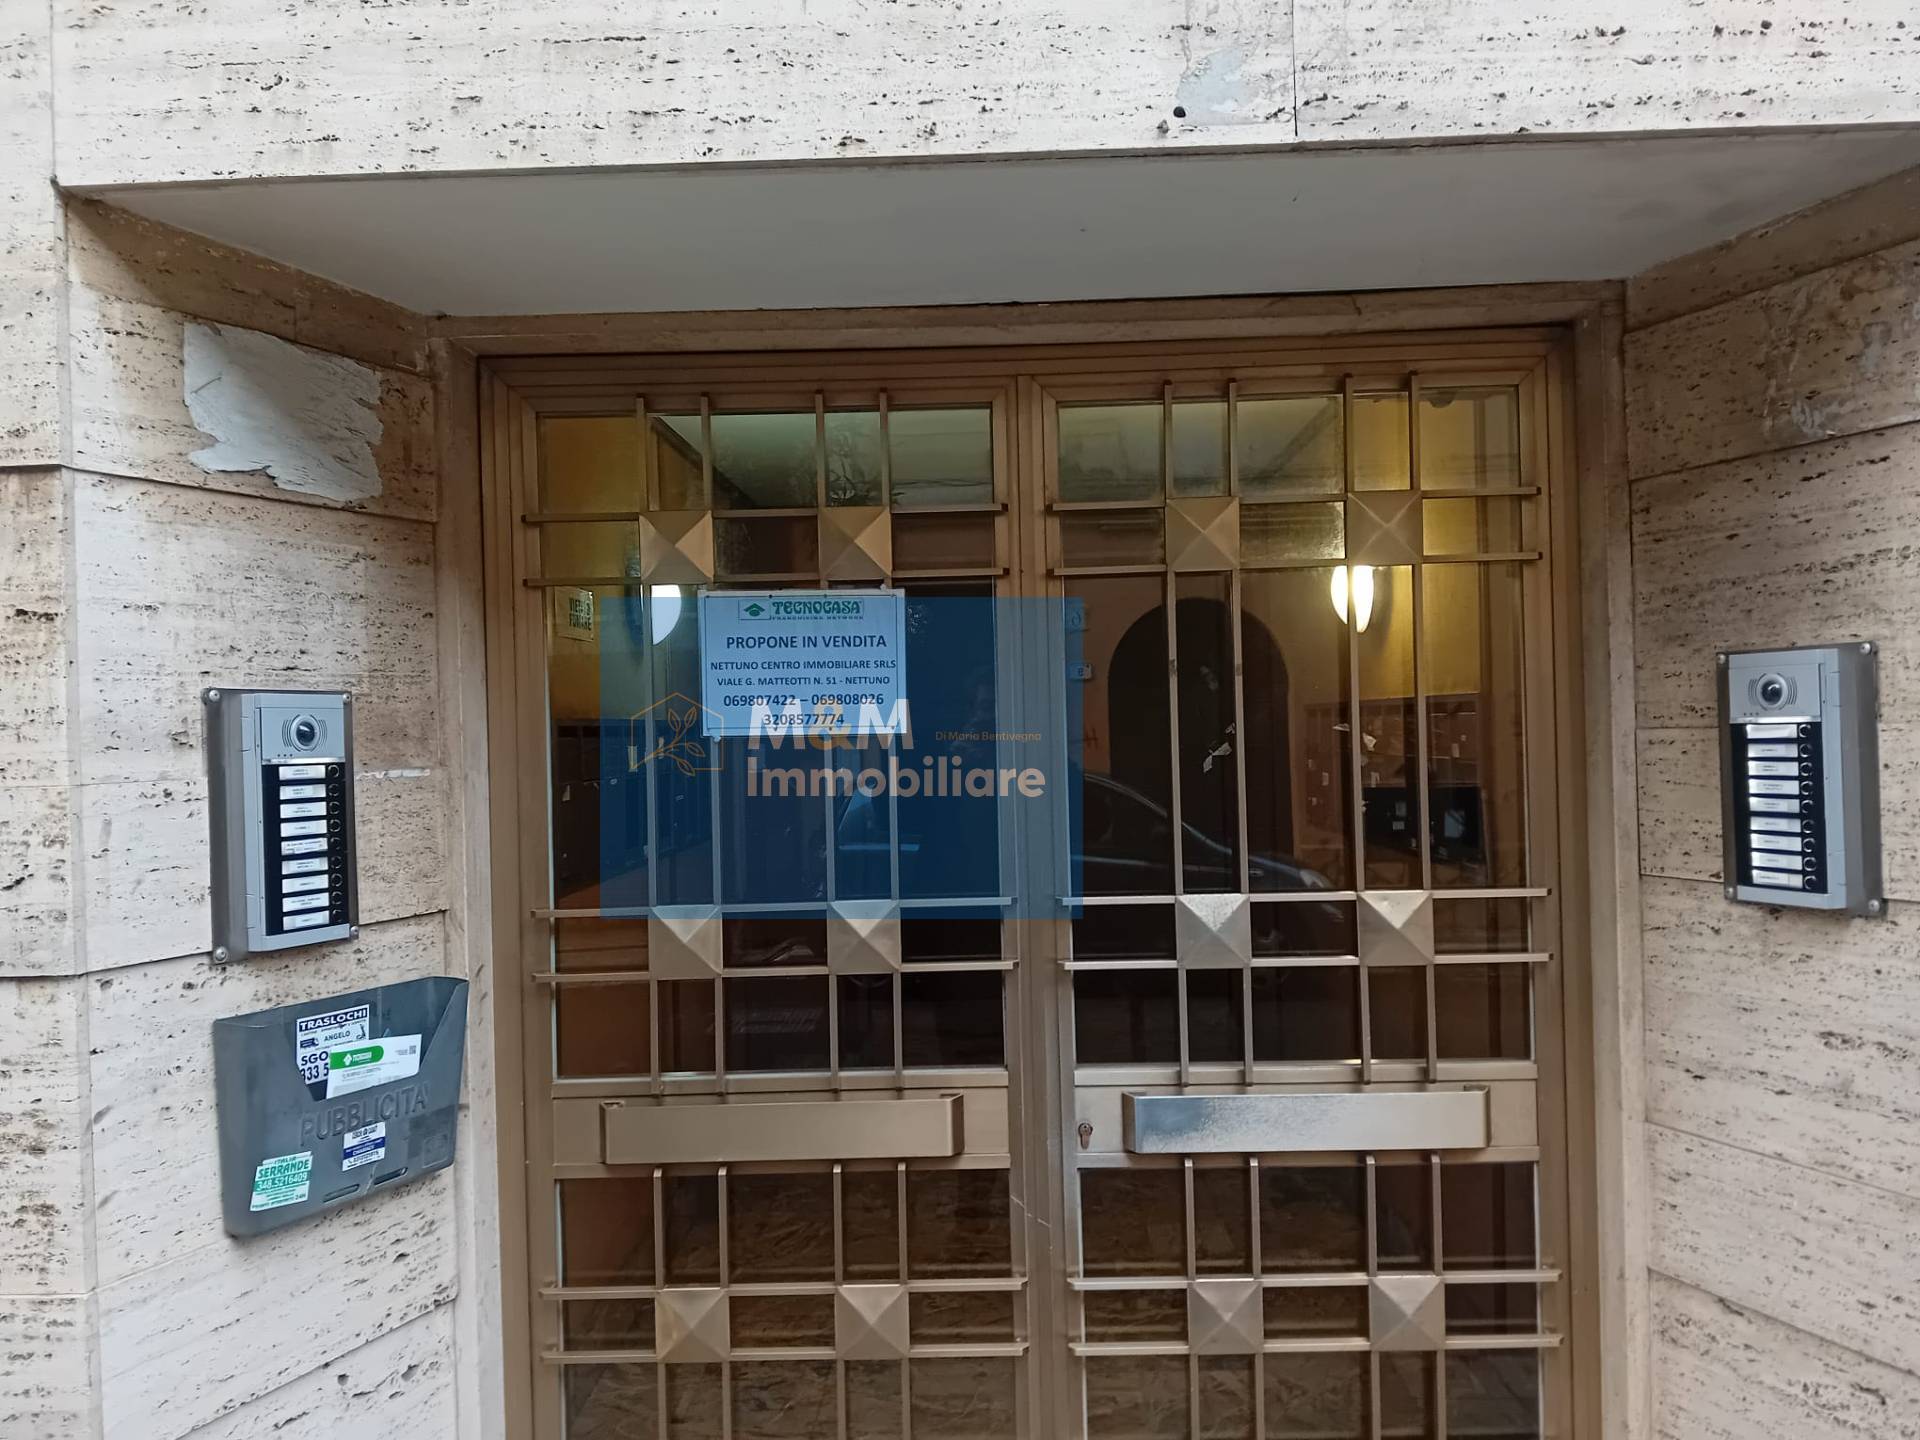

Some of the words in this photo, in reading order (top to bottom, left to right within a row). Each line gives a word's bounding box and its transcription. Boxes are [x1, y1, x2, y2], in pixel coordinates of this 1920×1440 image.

[772, 600, 860, 615] TECNOCASA
[726, 635, 798, 649] PROPONE
[802, 635, 818, 648] IN
[822, 634, 887, 648] VENDITA
[710, 661, 759, 671] NETTUNO
[761, 661, 800, 670] CENTRO
[803, 660, 871, 670] IMMOBILIARE
[873, 659, 896, 669] SRLS
[717, 677, 743, 686] VIALE
[745, 677, 755, 686] G.
[757, 676, 811, 686] MATTEOTTI
[813, 676, 824, 685] N.
[826, 676, 837, 685] 51
[845, 676, 890, 685] NETTUNO
[723, 694, 796, 707] 069807422
[811, 693, 884, 706] 069808026
[764, 713, 845, 726] 3208577774
[300, 1009, 367, 1031] TRASLOCHI
[324, 1030, 351, 1042] ANGELO
[257, 1160, 309, 1179] SERRANDE
